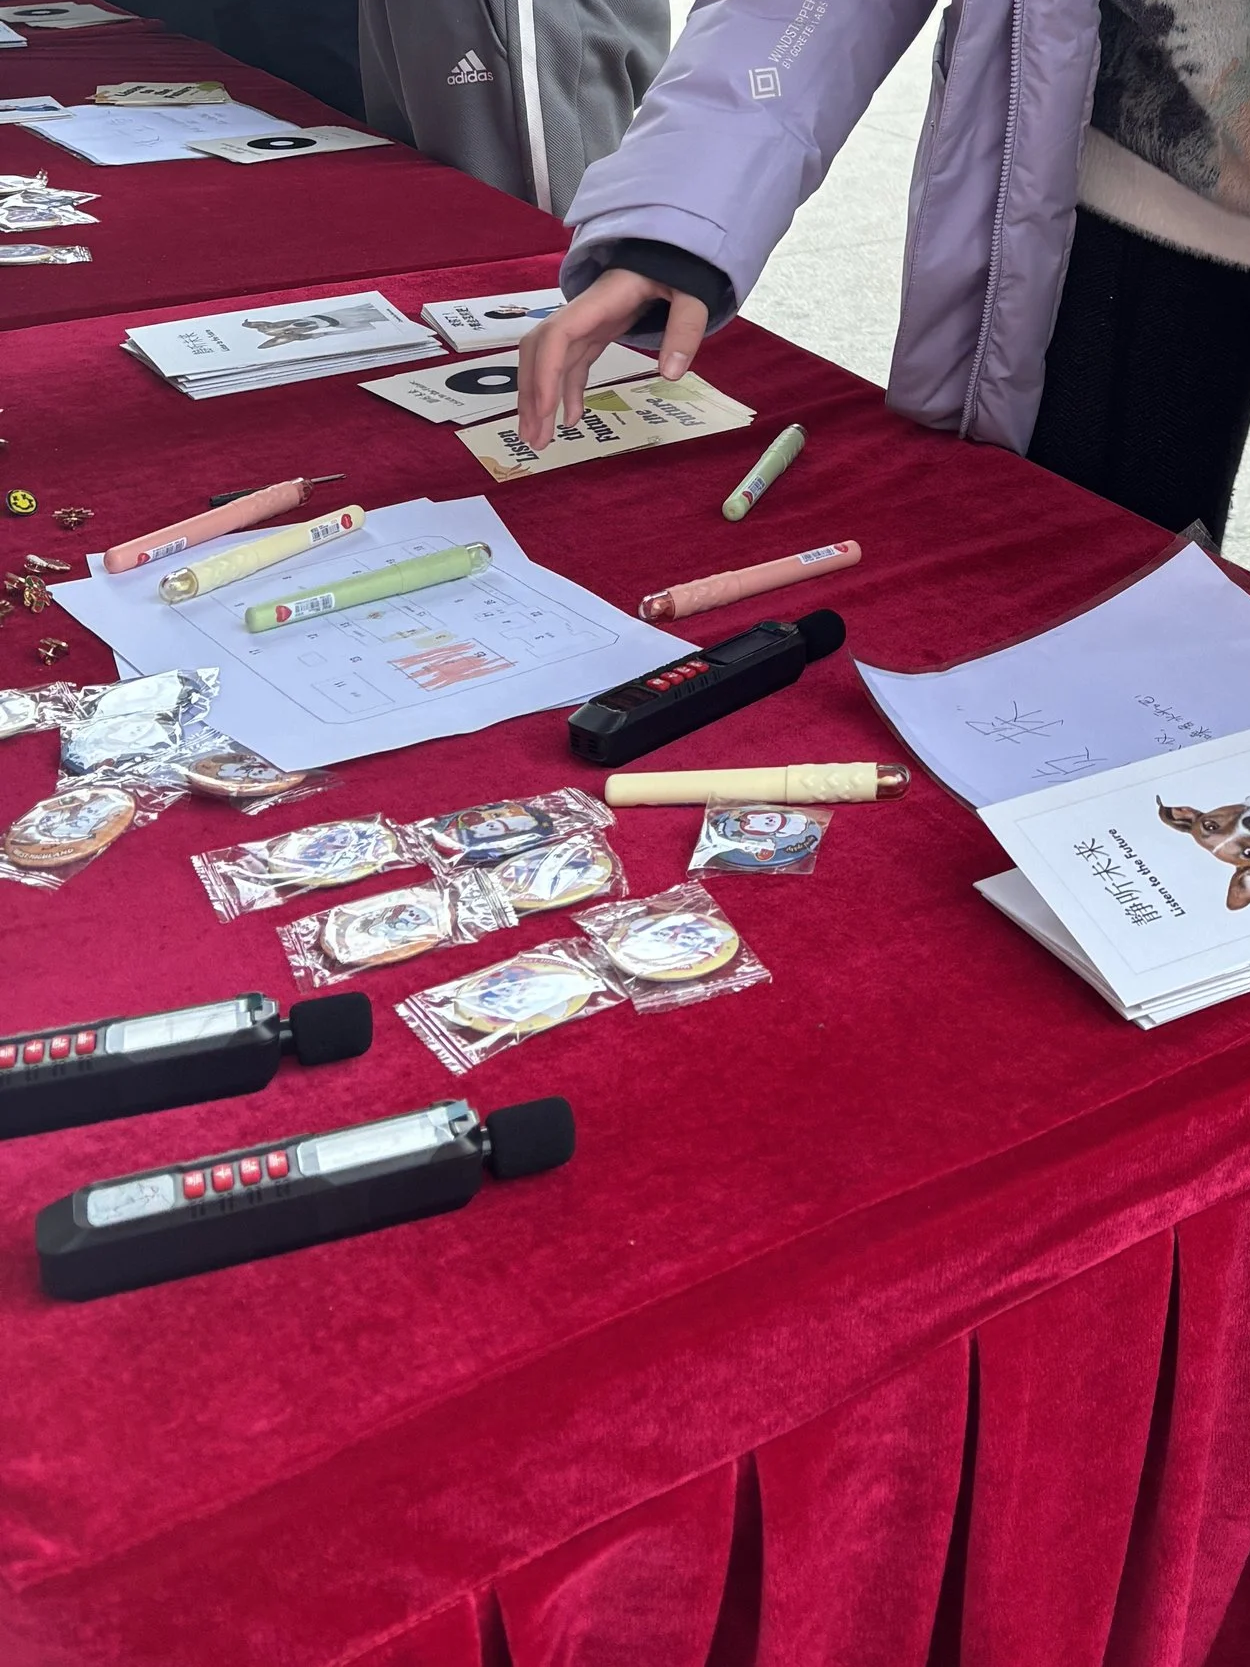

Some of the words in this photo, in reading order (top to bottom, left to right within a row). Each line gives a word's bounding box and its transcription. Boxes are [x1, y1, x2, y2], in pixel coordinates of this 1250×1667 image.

[447, 68, 494, 86] adidas
[646, 397, 707, 427] Future
[497, 429, 540, 462] Listen
[1103, 827, 1139, 859] Future
[1074, 837, 1163, 927] 静听未来
[1129, 858, 1152, 876] the
[1143, 875, 1162, 887] to
[1152, 886, 1187, 917] Listen
